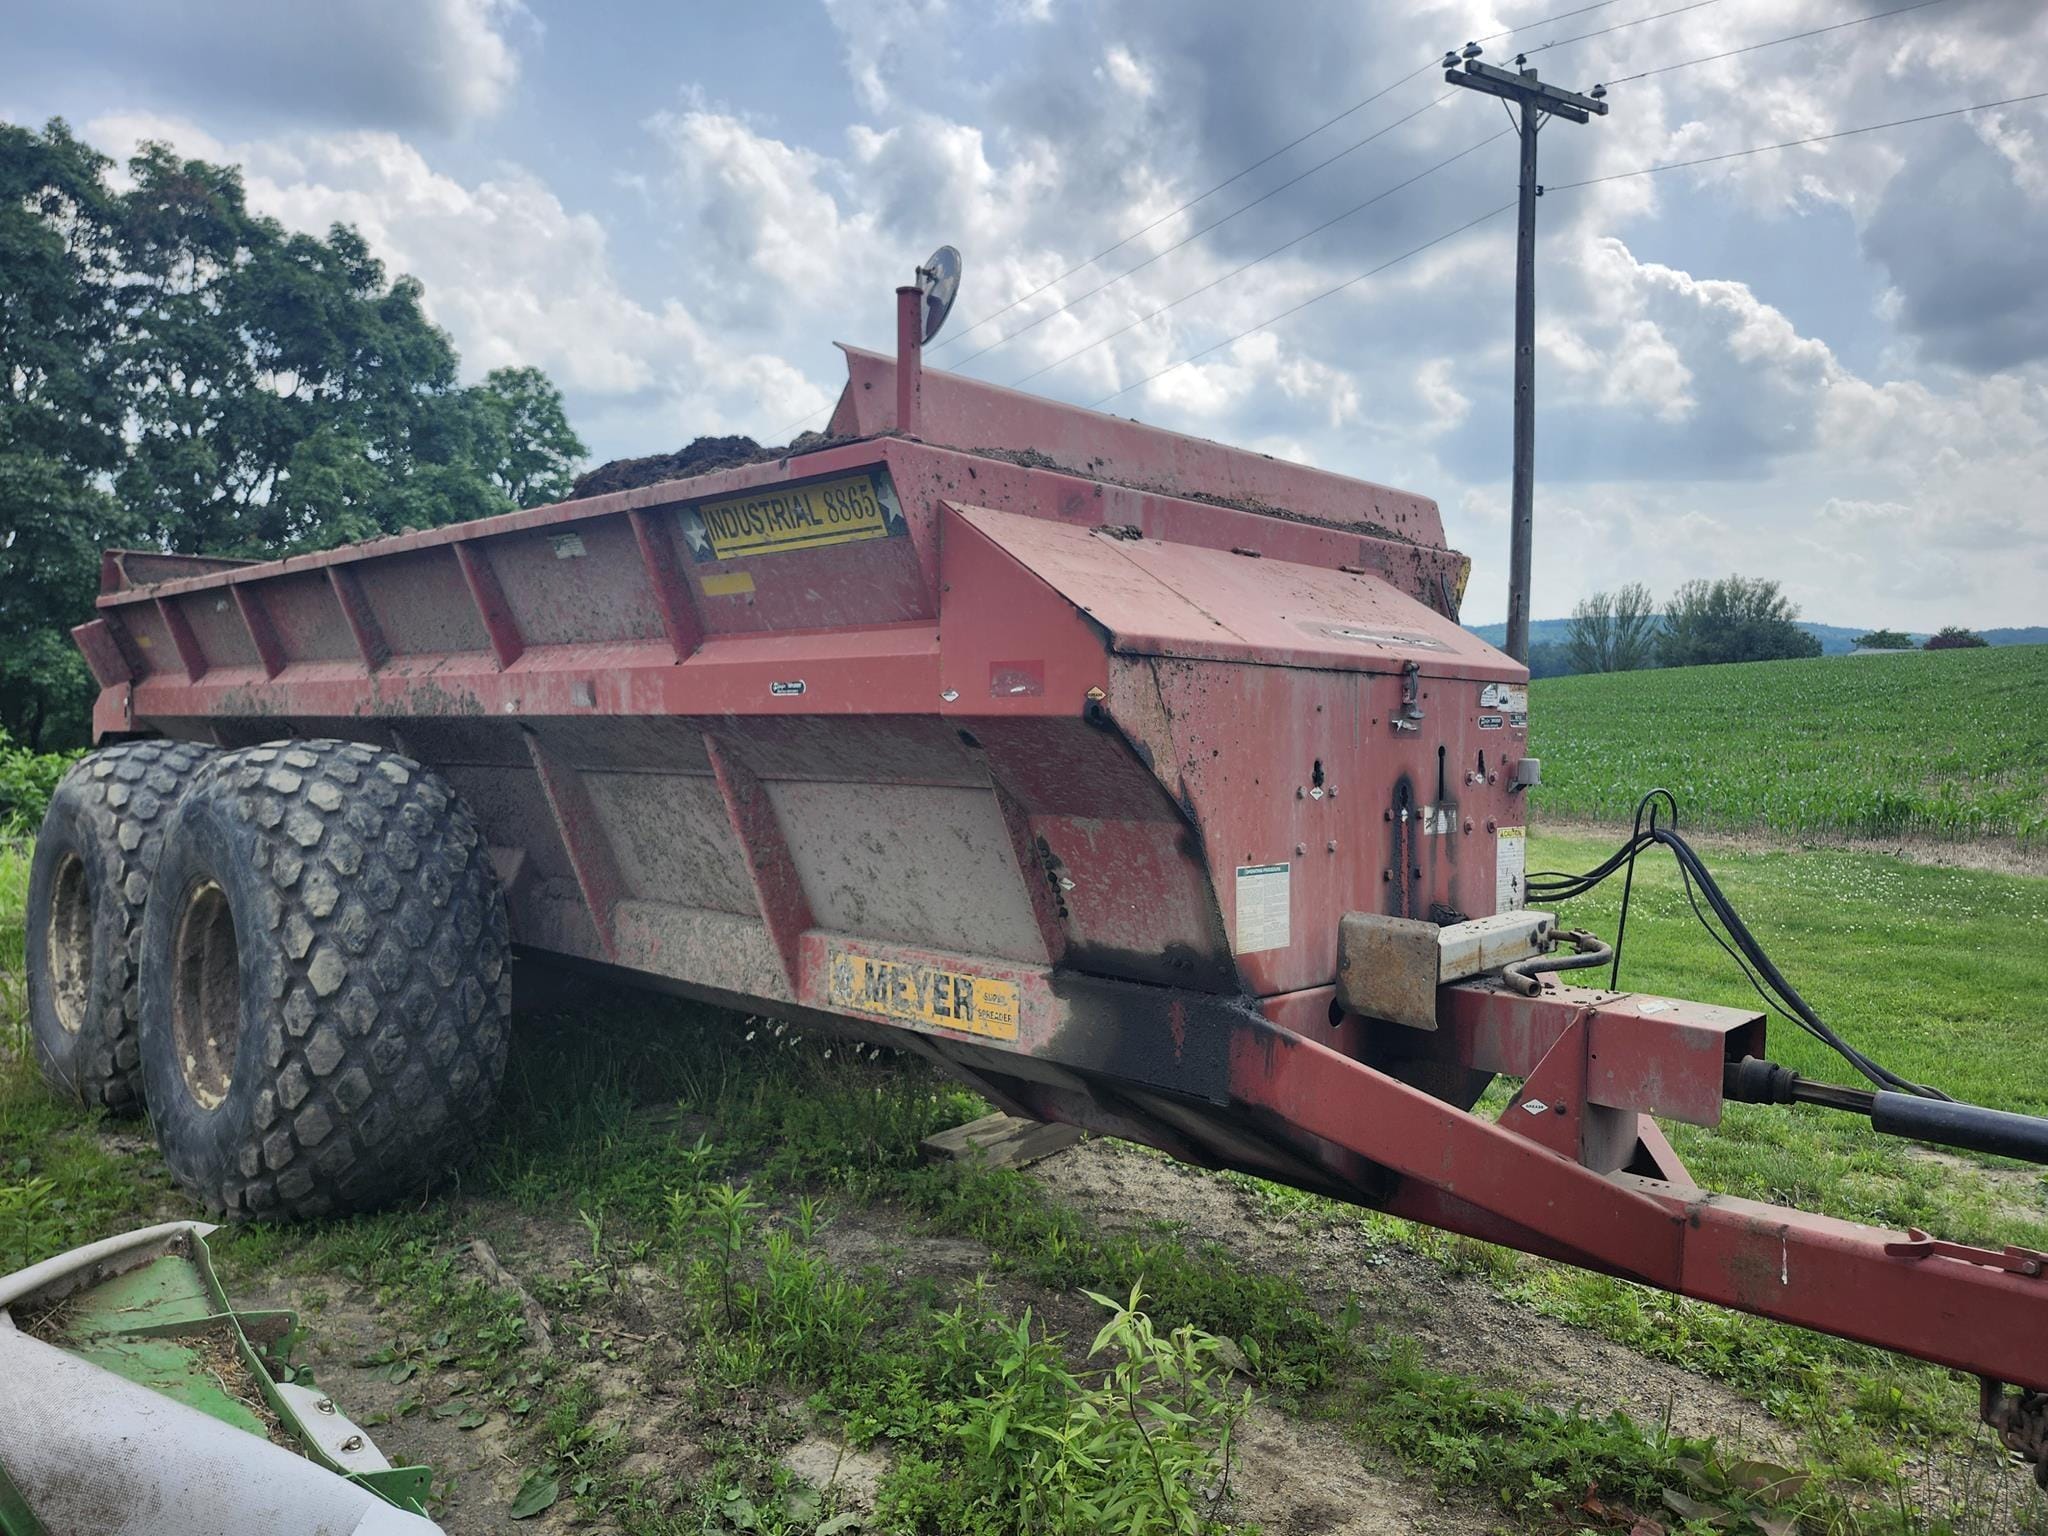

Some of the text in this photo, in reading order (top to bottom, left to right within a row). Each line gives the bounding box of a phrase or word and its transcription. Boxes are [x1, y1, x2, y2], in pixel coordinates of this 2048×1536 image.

[704, 484, 876, 541] INDUSTRIAL 8865
[865, 961, 974, 1021] MEYER
[978, 1008, 1012, 1023] SPREADER
